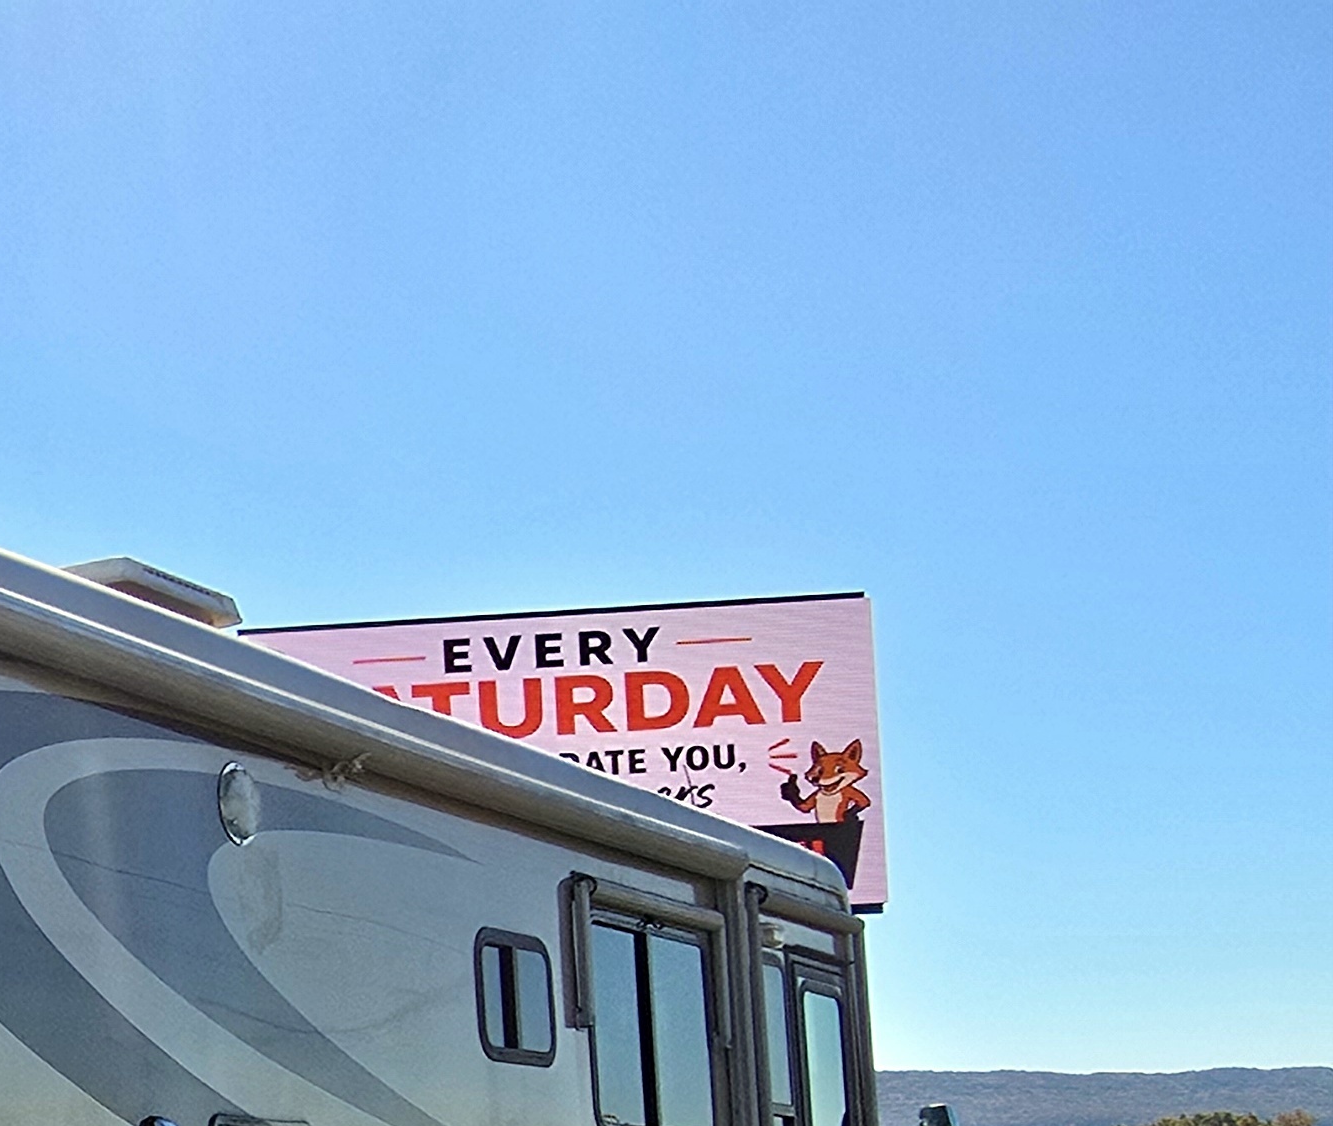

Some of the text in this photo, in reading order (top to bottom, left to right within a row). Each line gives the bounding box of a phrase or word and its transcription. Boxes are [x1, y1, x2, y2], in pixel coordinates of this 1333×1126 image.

[443, 626, 660, 674] EVERY
[372, 660, 824, 738] TURDAY
[661, 743, 747, 773] YOU,
